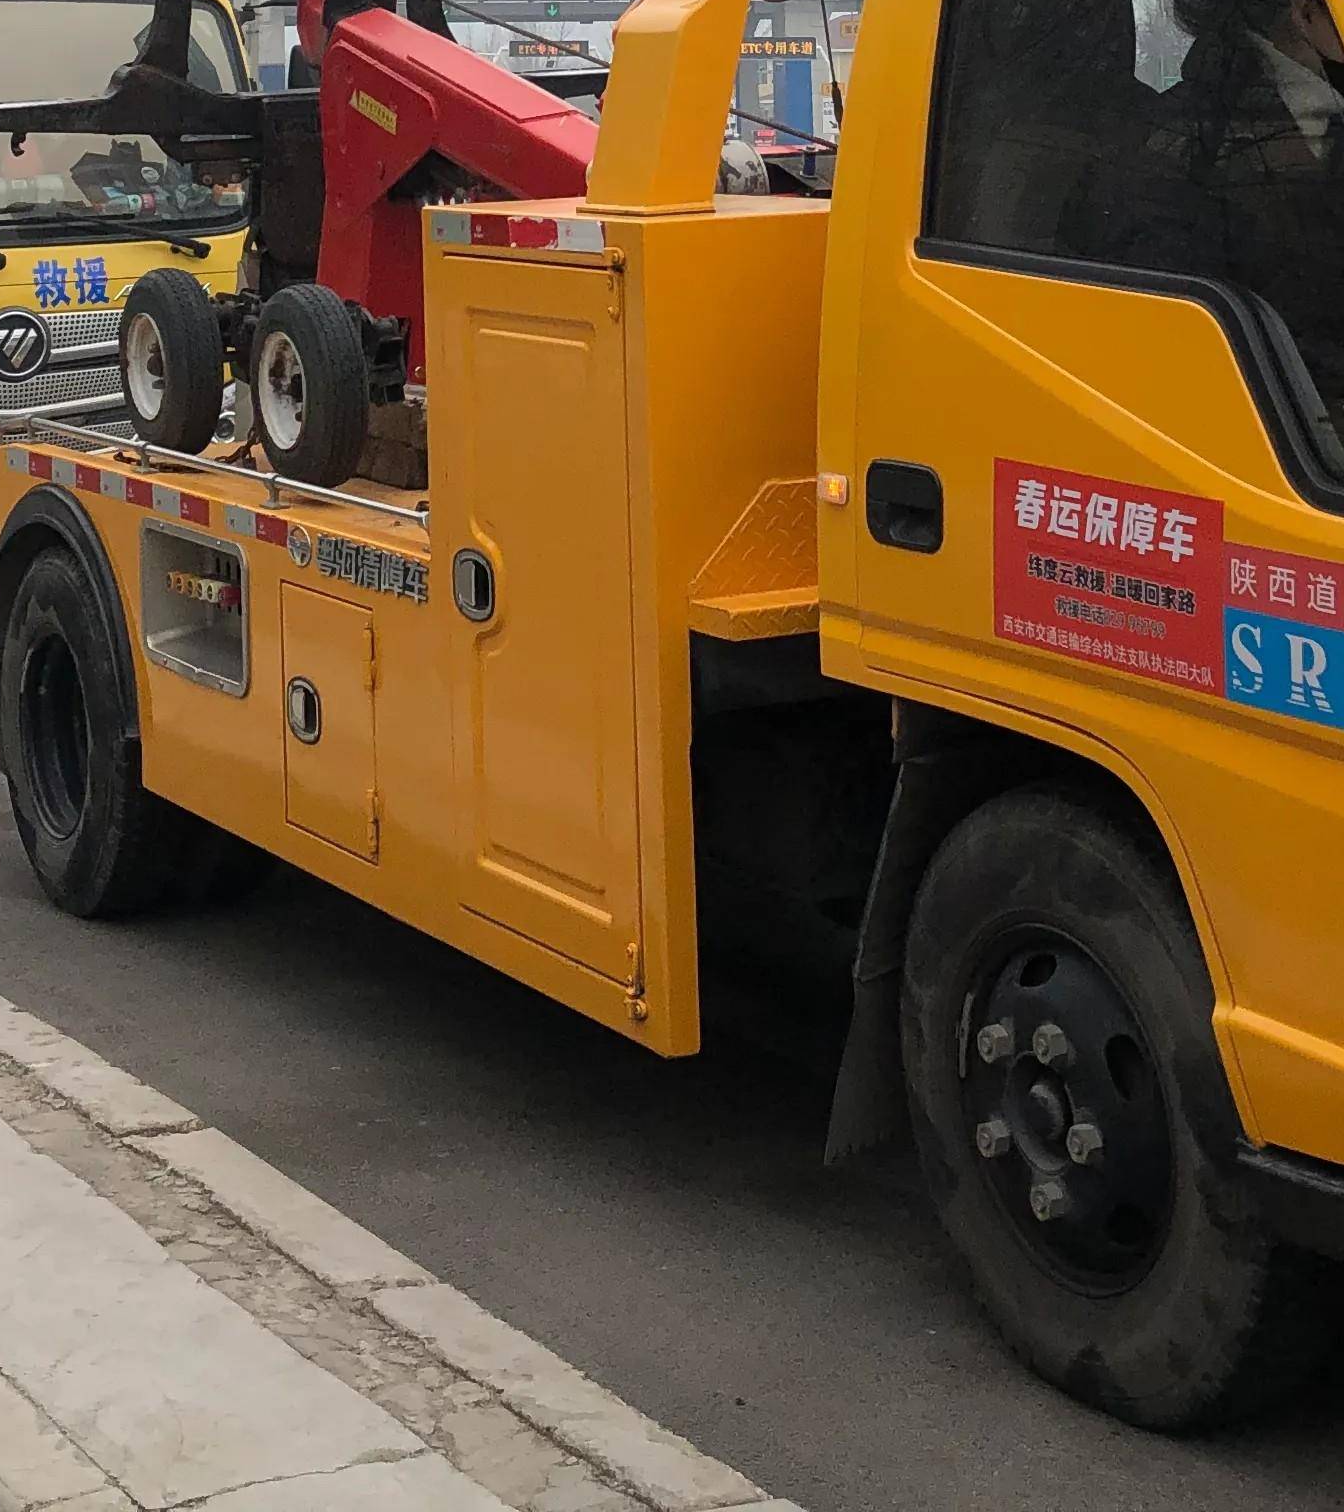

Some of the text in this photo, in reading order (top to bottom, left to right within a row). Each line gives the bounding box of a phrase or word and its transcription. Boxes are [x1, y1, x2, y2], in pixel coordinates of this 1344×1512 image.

[739, 41, 814, 56] ETC专用车道
[1013, 478, 1199, 565] 春运保障车
[1003, 614, 1215, 688] 西安市交通运输综合执法支队执法四大队
